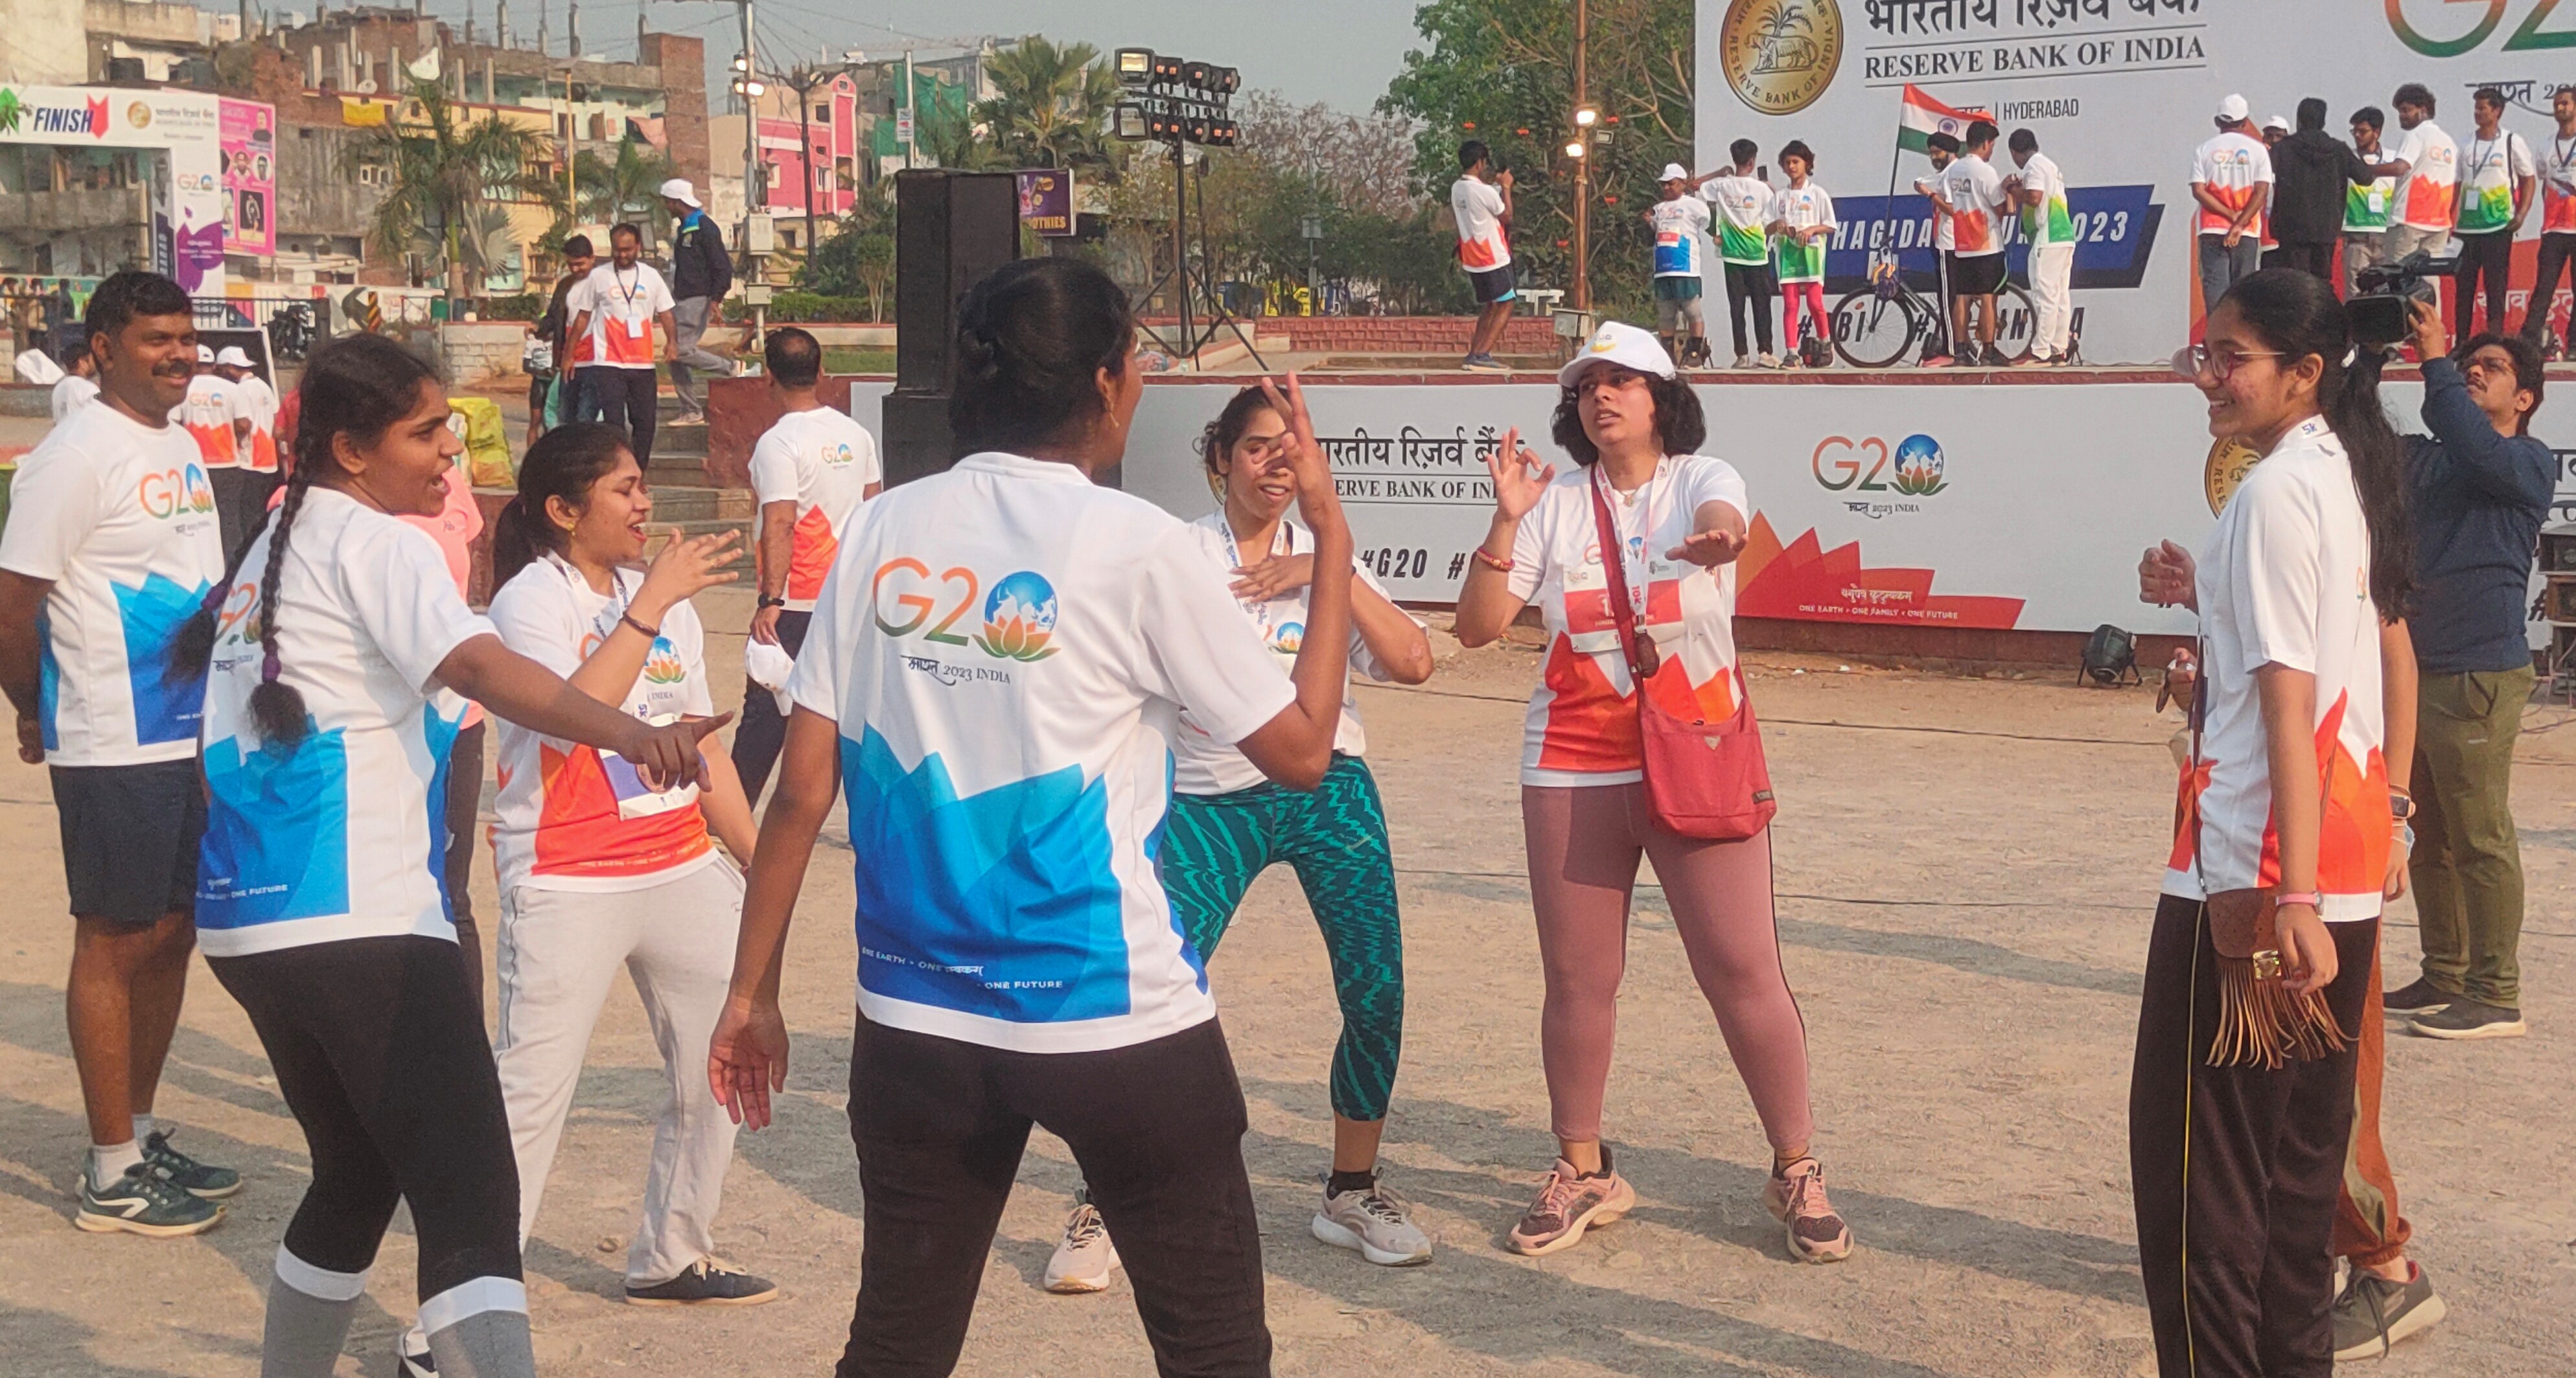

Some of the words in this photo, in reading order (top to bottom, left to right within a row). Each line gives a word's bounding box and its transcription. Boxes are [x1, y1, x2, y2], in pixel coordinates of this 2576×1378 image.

[1730, 35, 1761, 98] RESERVE
[1765, 89, 1802, 104] BANK
[1804, 74, 1818, 91] OF
[1818, 27, 1834, 71] INDIA
[1864, 50, 1984, 78] RESERVE
[1993, 43, 2069, 71] BANK
[2077, 41, 2115, 65] OF
[2123, 35, 2205, 63] INDIA
[33, 107, 94, 133] FINISH
[2003, 98, 2079, 121] HYDERABAD
[1831, 217, 1933, 251] HAGIDA
[2074, 211, 2128, 242] 023
[1335, 479, 1380, 497] ERVE
[1386, 481, 1437, 499] BANK
[1441, 481, 1467, 499] OF
[2213, 468, 2228, 505] RESE
[872, 557, 1062, 663] G20
[1817, 606, 1844, 614] EARTH
[1926, 611, 1958, 620] FUTURE
[943, 665, 973, 682] 2023
[976, 667, 1011, 684] INDIA
[249, 884, 288, 897] FUTURE
[876, 950, 906, 965] EARTH
[1014, 980, 1063, 989] FUTURE
